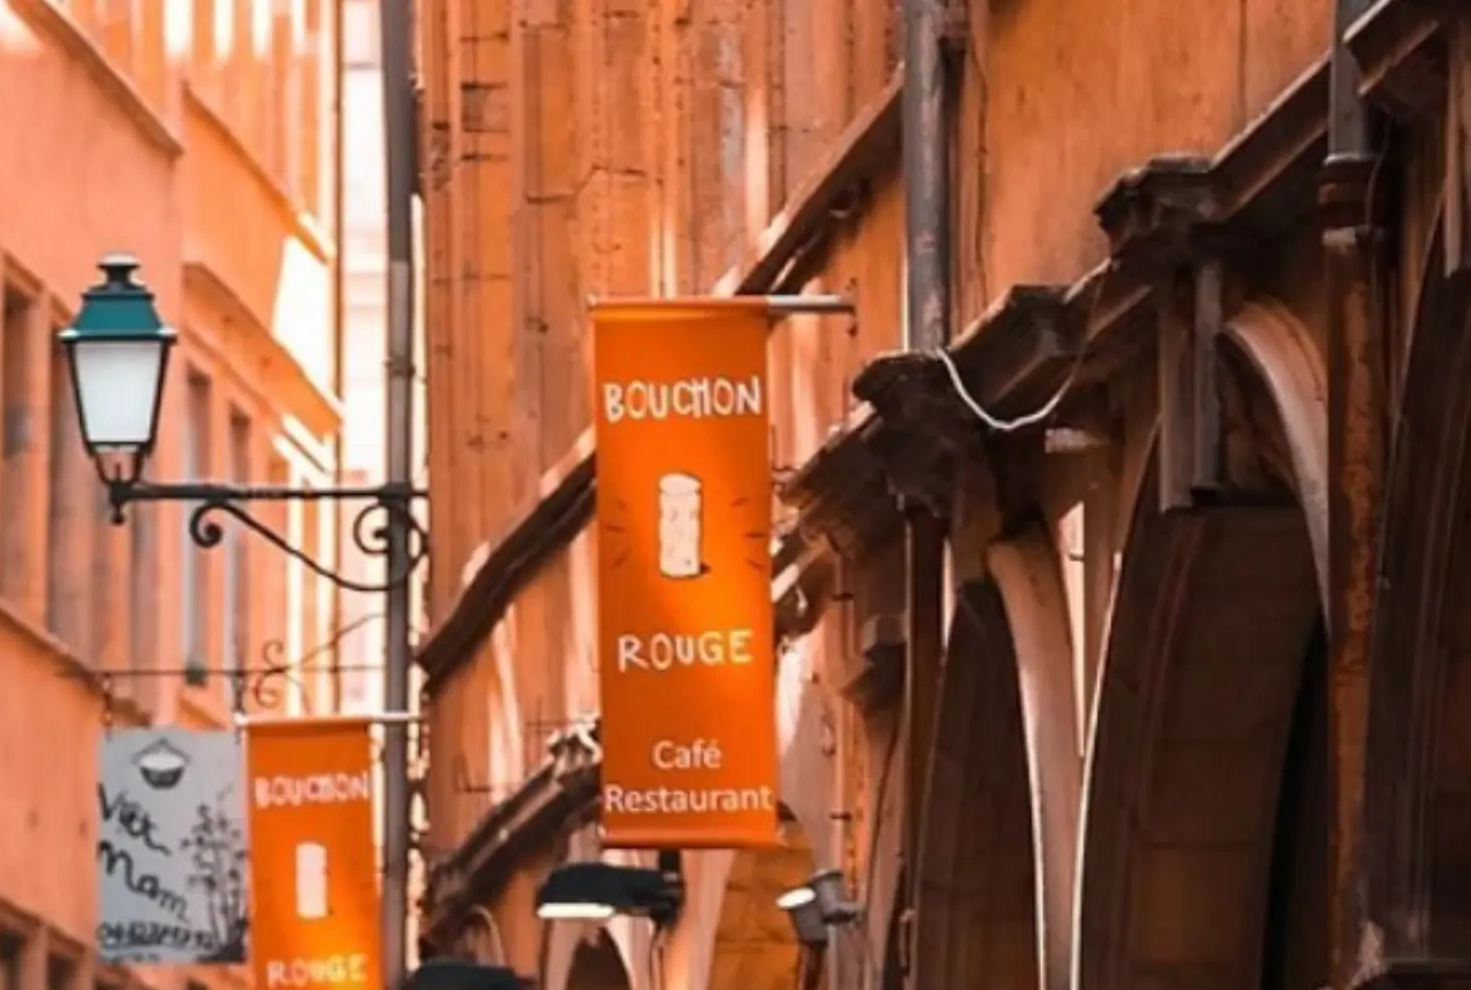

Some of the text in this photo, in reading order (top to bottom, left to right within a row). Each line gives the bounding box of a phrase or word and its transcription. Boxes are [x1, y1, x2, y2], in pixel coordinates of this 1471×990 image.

[603, 376, 762, 424] BOUCHON
[617, 629, 754, 673] ROUGE
[653, 737, 723, 770] Café
[603, 782, 773, 813] Restaurant
